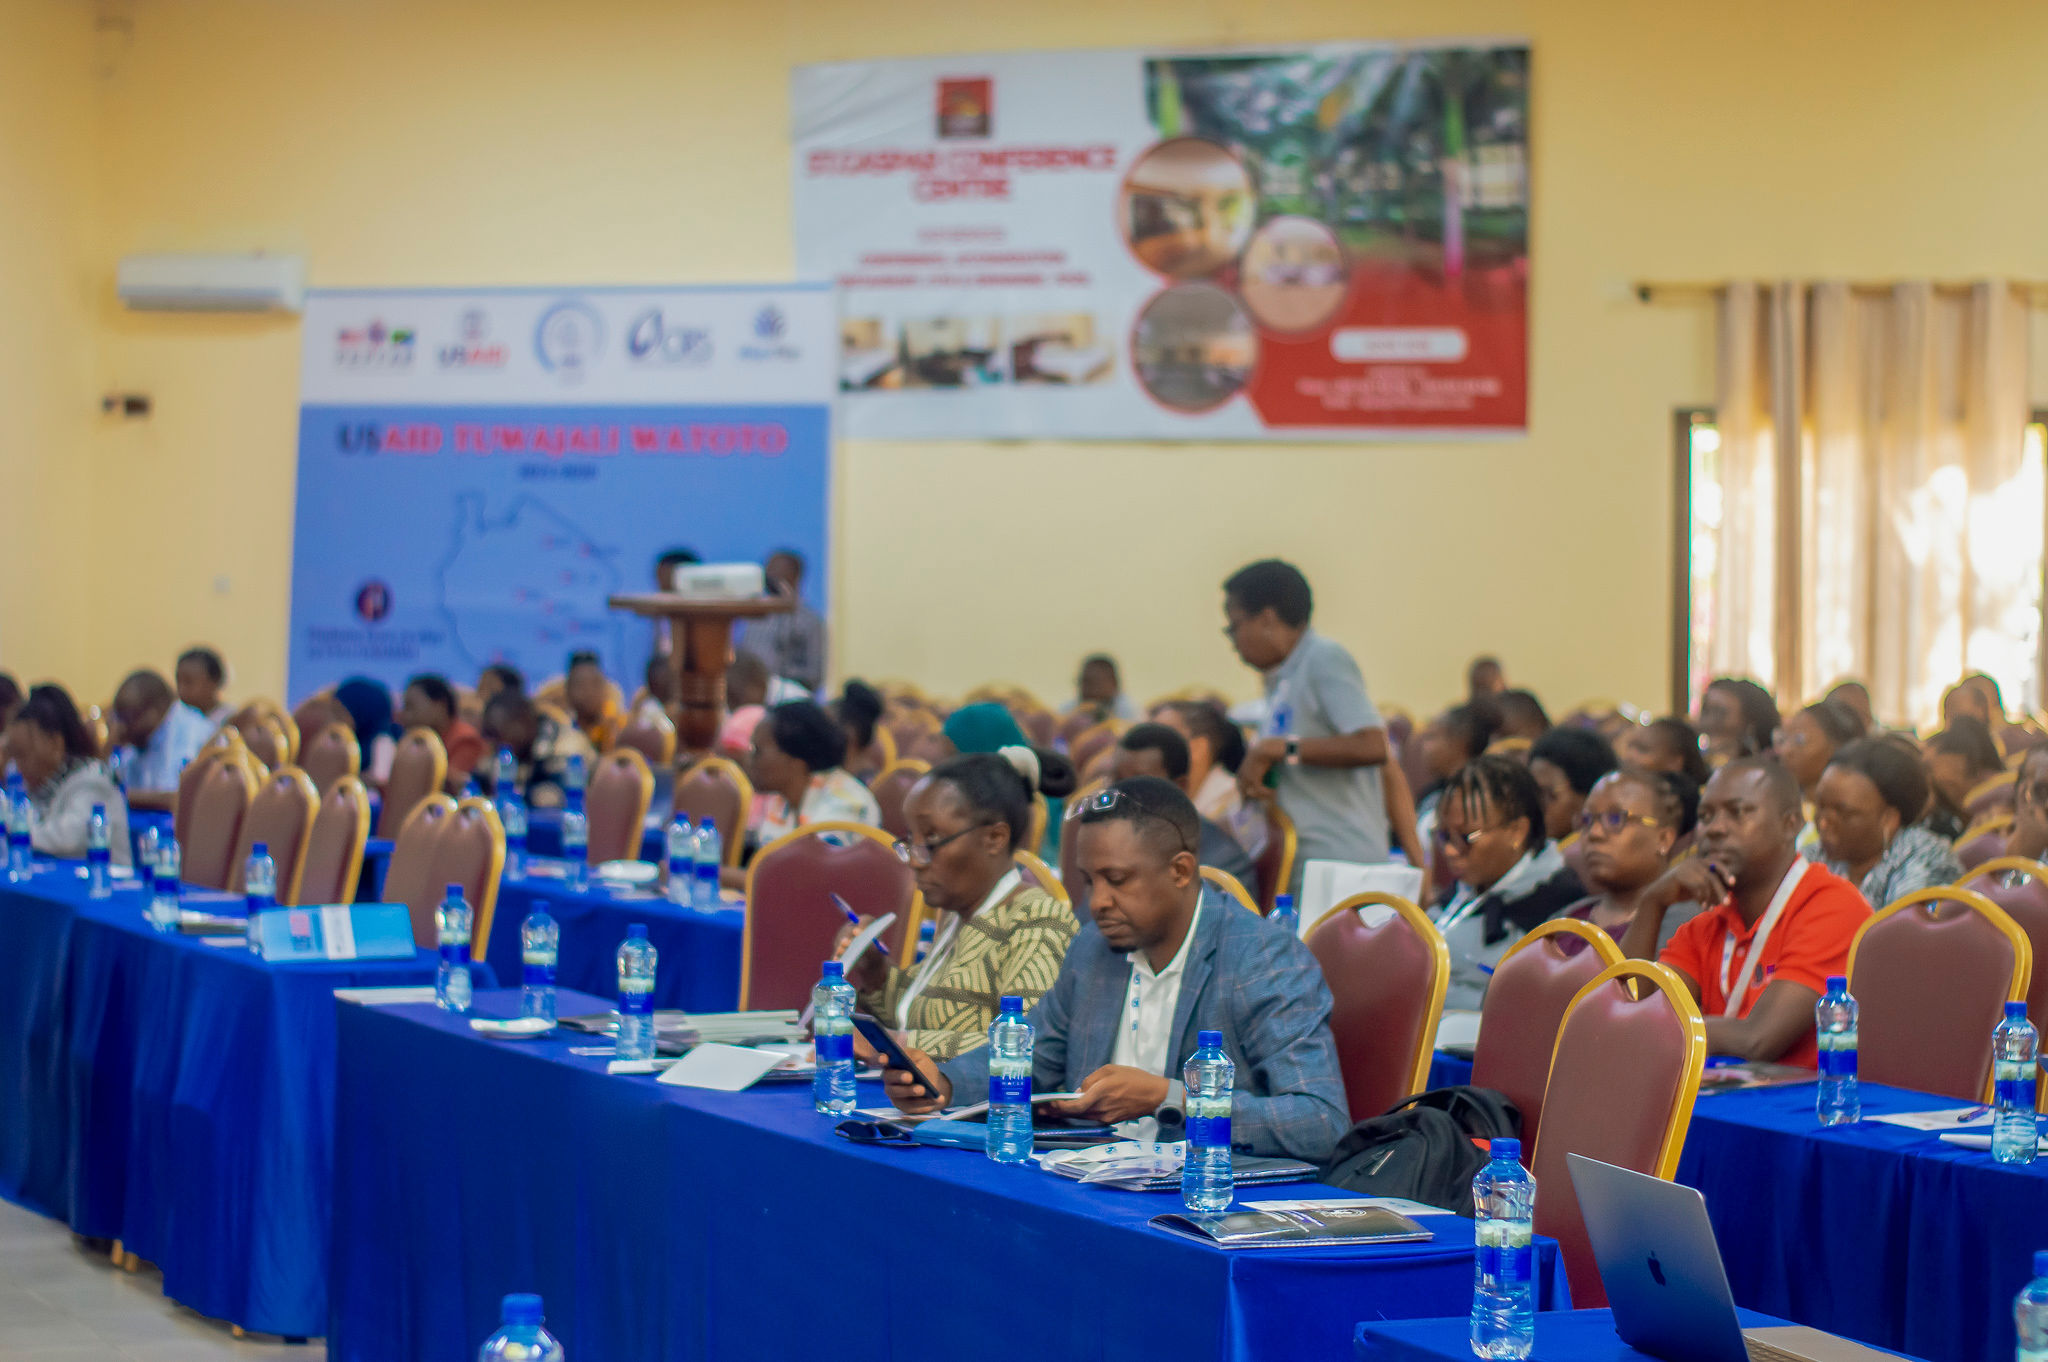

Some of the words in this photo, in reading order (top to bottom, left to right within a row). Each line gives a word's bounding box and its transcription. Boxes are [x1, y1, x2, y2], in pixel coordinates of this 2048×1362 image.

[947, 145, 1116, 172] CONFERENCE
[914, 178, 1010, 200] CENTRE
[337, 423, 442, 454] USAID
[453, 423, 620, 458] TUWAJALI
[630, 422, 789, 455] WATOTO
